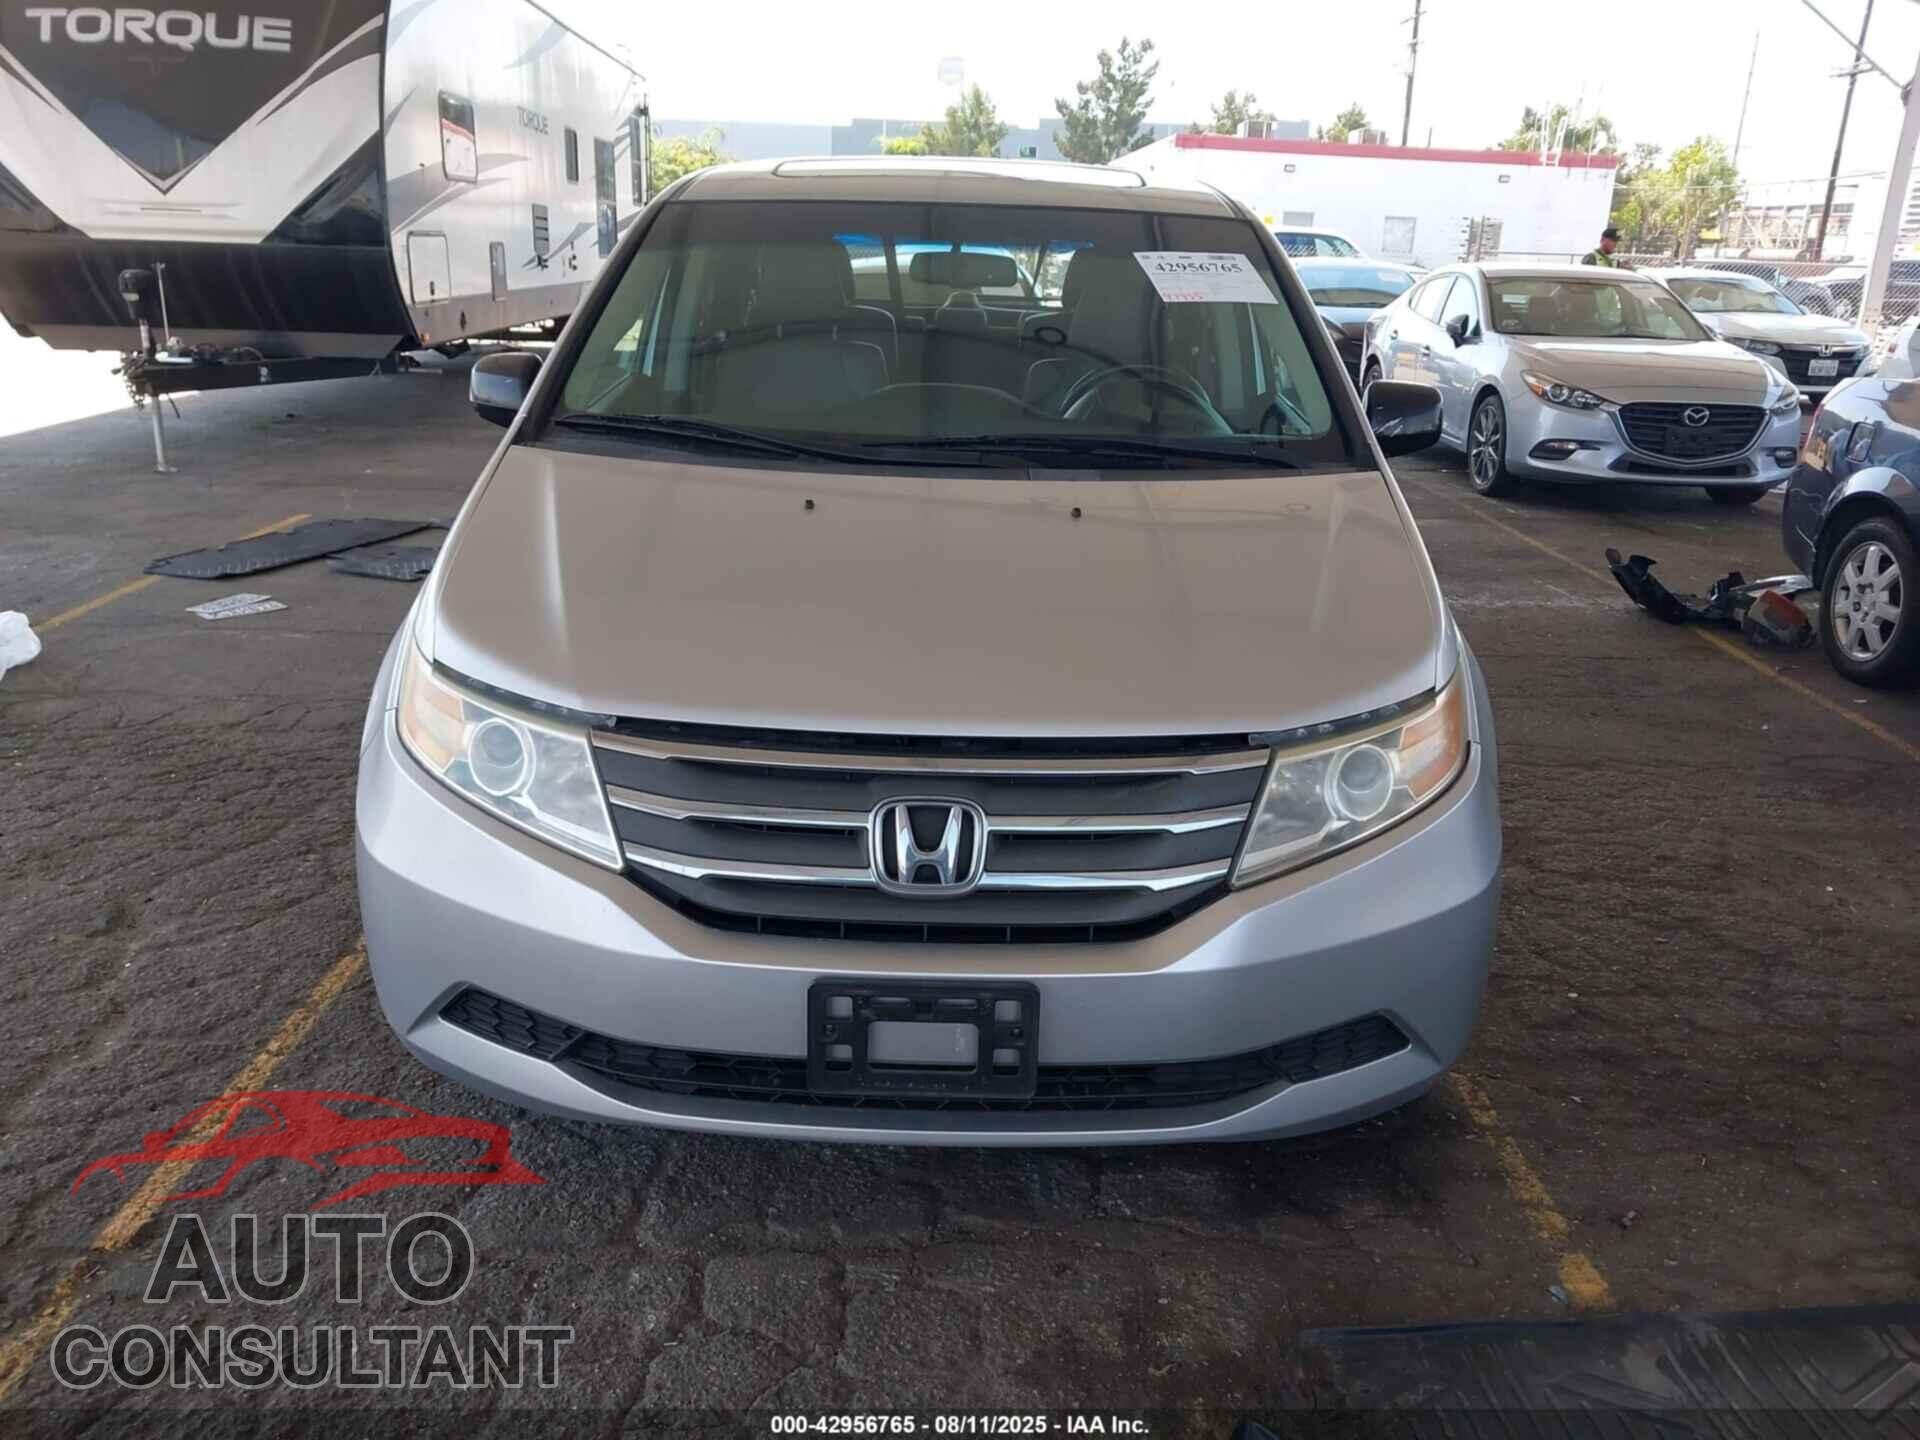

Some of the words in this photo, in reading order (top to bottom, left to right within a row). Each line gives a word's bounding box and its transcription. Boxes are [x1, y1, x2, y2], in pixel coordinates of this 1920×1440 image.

[25, 7, 292, 51] TORQUE
[516, 105, 549, 135] TORQUE
[1155, 262, 1243, 273] 42956765
